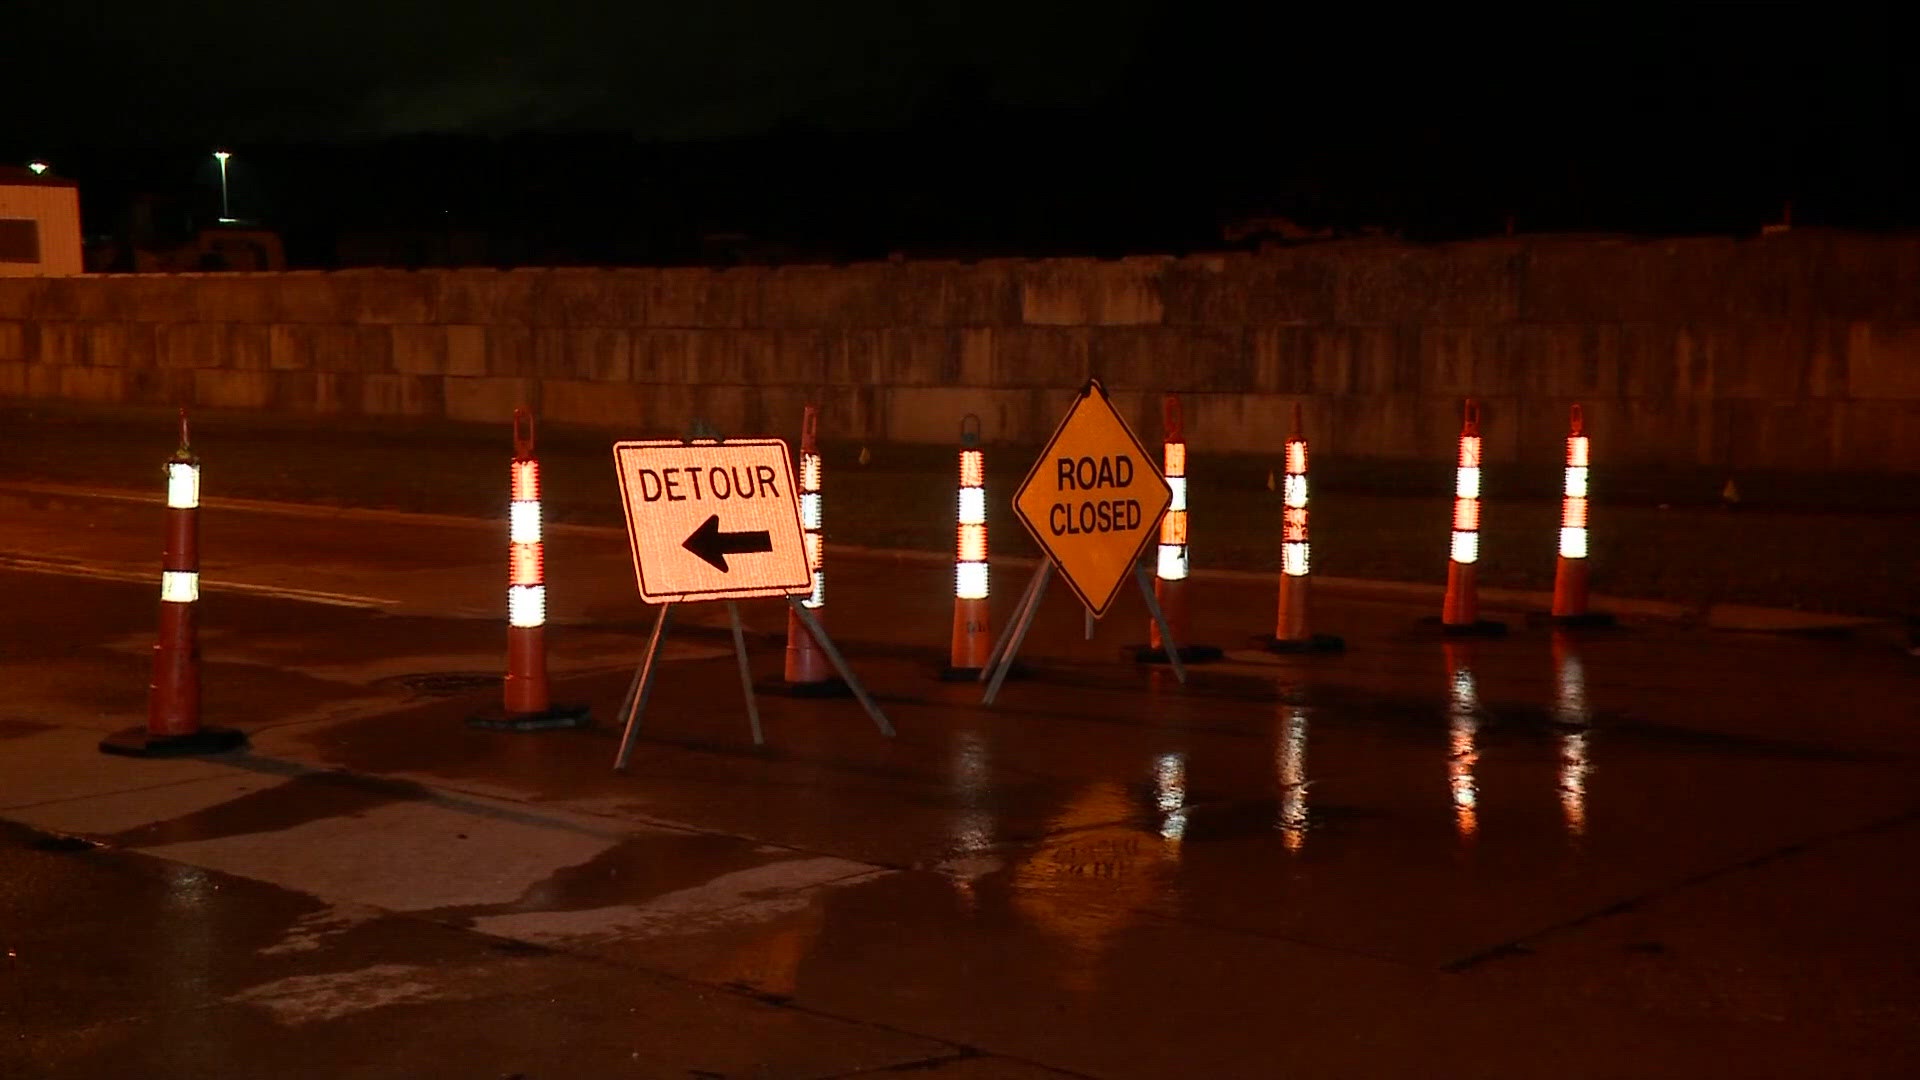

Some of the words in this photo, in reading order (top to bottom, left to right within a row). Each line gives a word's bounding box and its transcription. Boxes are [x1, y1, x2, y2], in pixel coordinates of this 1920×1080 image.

[639, 466, 780, 501] DETOUR
[1057, 455, 1133, 490] ROAD
[1049, 500, 1141, 536] CLOSED
